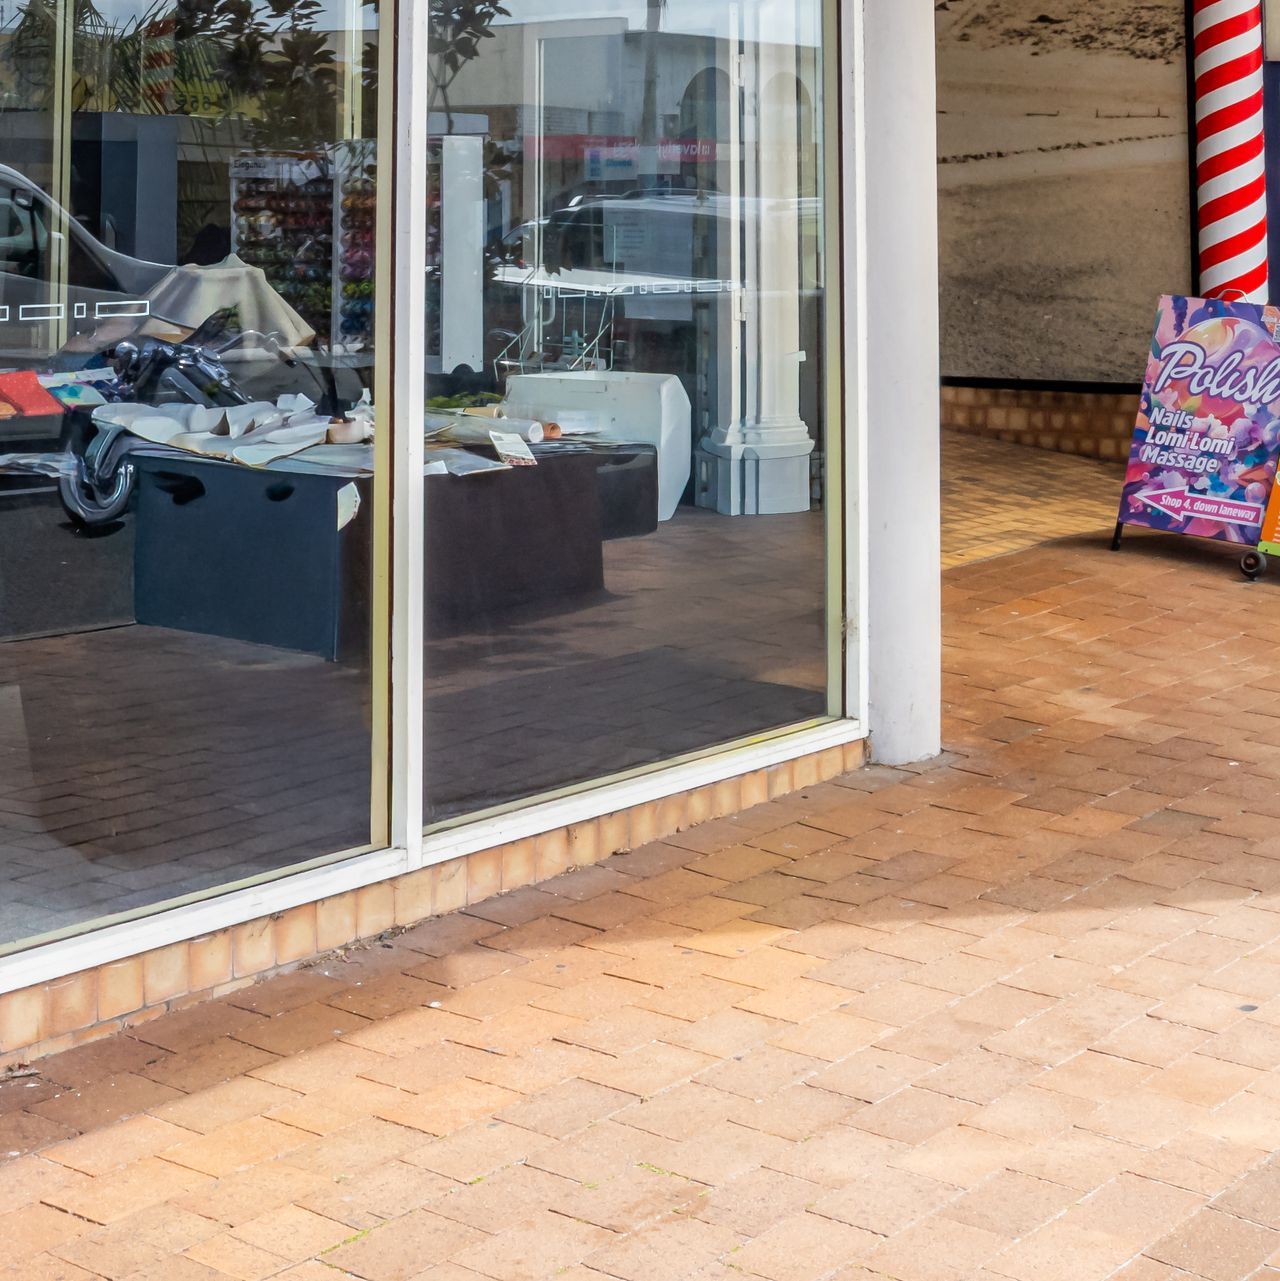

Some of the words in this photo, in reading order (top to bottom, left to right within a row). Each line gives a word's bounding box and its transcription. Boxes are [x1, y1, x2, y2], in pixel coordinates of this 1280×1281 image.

[1149, 407, 1194, 429] Nails
[1145, 427, 1188, 448] Lomi
[1189, 432, 1235, 455] Lomi
[1141, 446, 1218, 473] Massage
[1160, 495, 1182, 508] Shop
[1183, 499, 1191, 510] 4,
[1193, 500, 1218, 513] down
[1219, 505, 1256, 520] laneway
